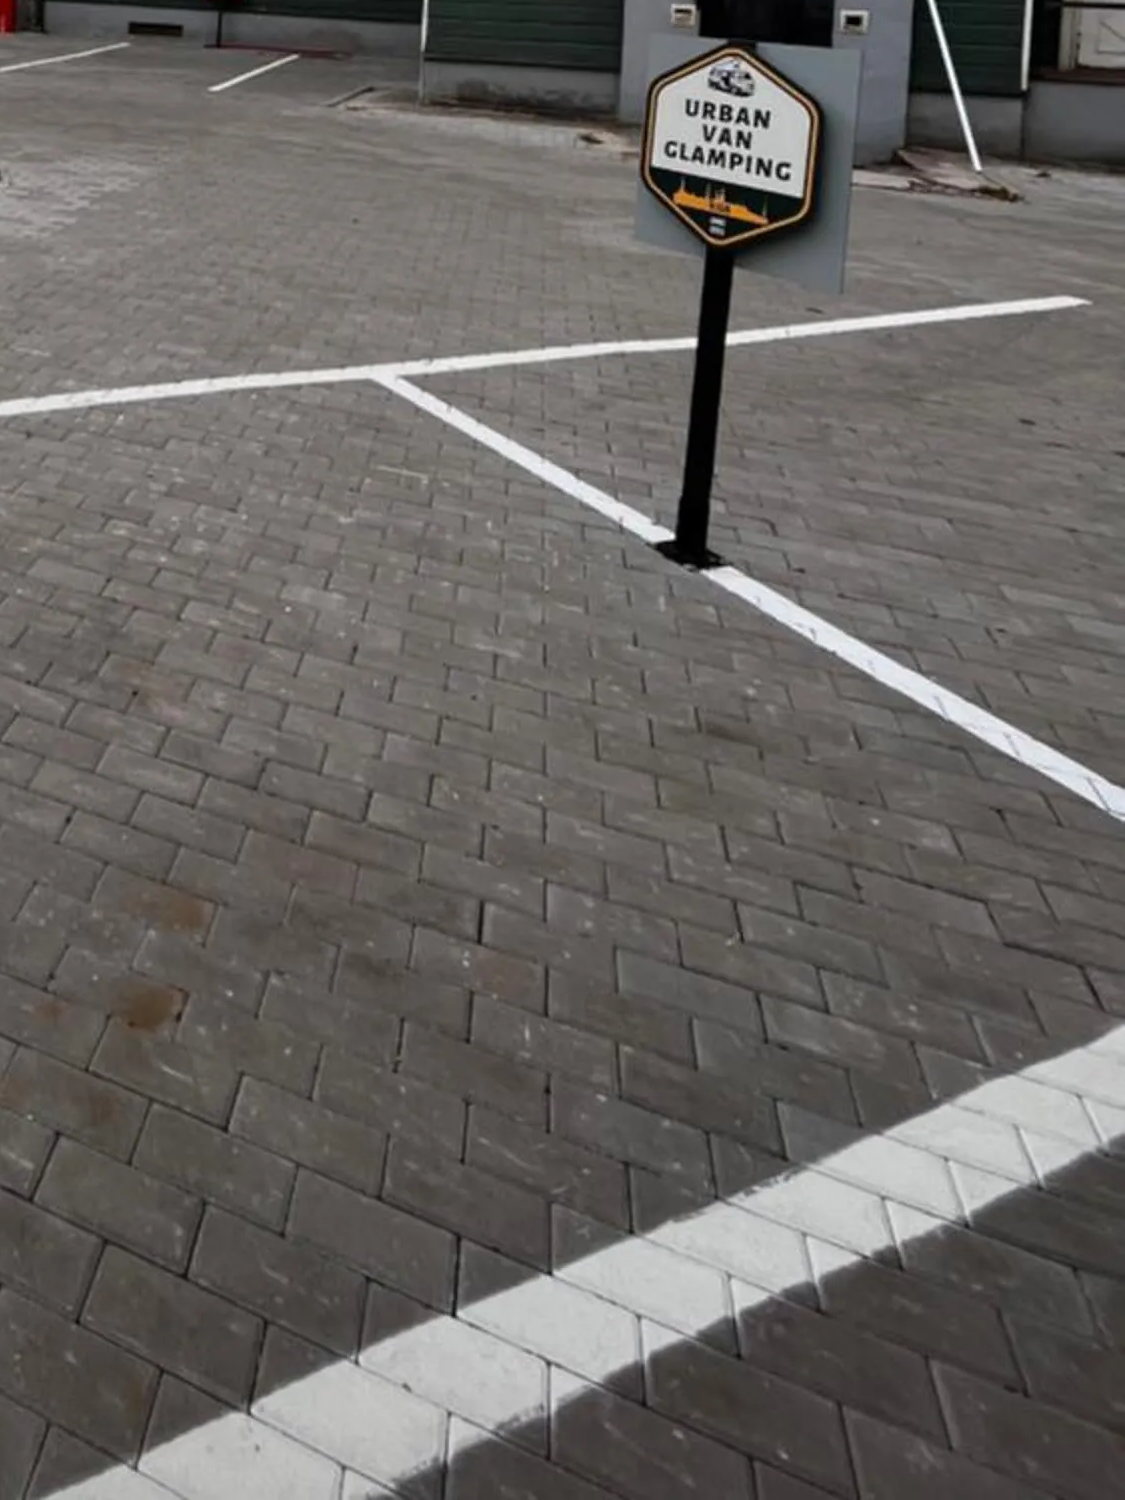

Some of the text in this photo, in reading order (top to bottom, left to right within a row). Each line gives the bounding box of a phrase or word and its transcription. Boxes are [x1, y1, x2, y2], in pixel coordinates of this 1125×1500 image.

[685, 99, 771, 129] URBAN
[703, 124, 752, 149] VAN
[664, 140, 792, 181] GLAMPING
